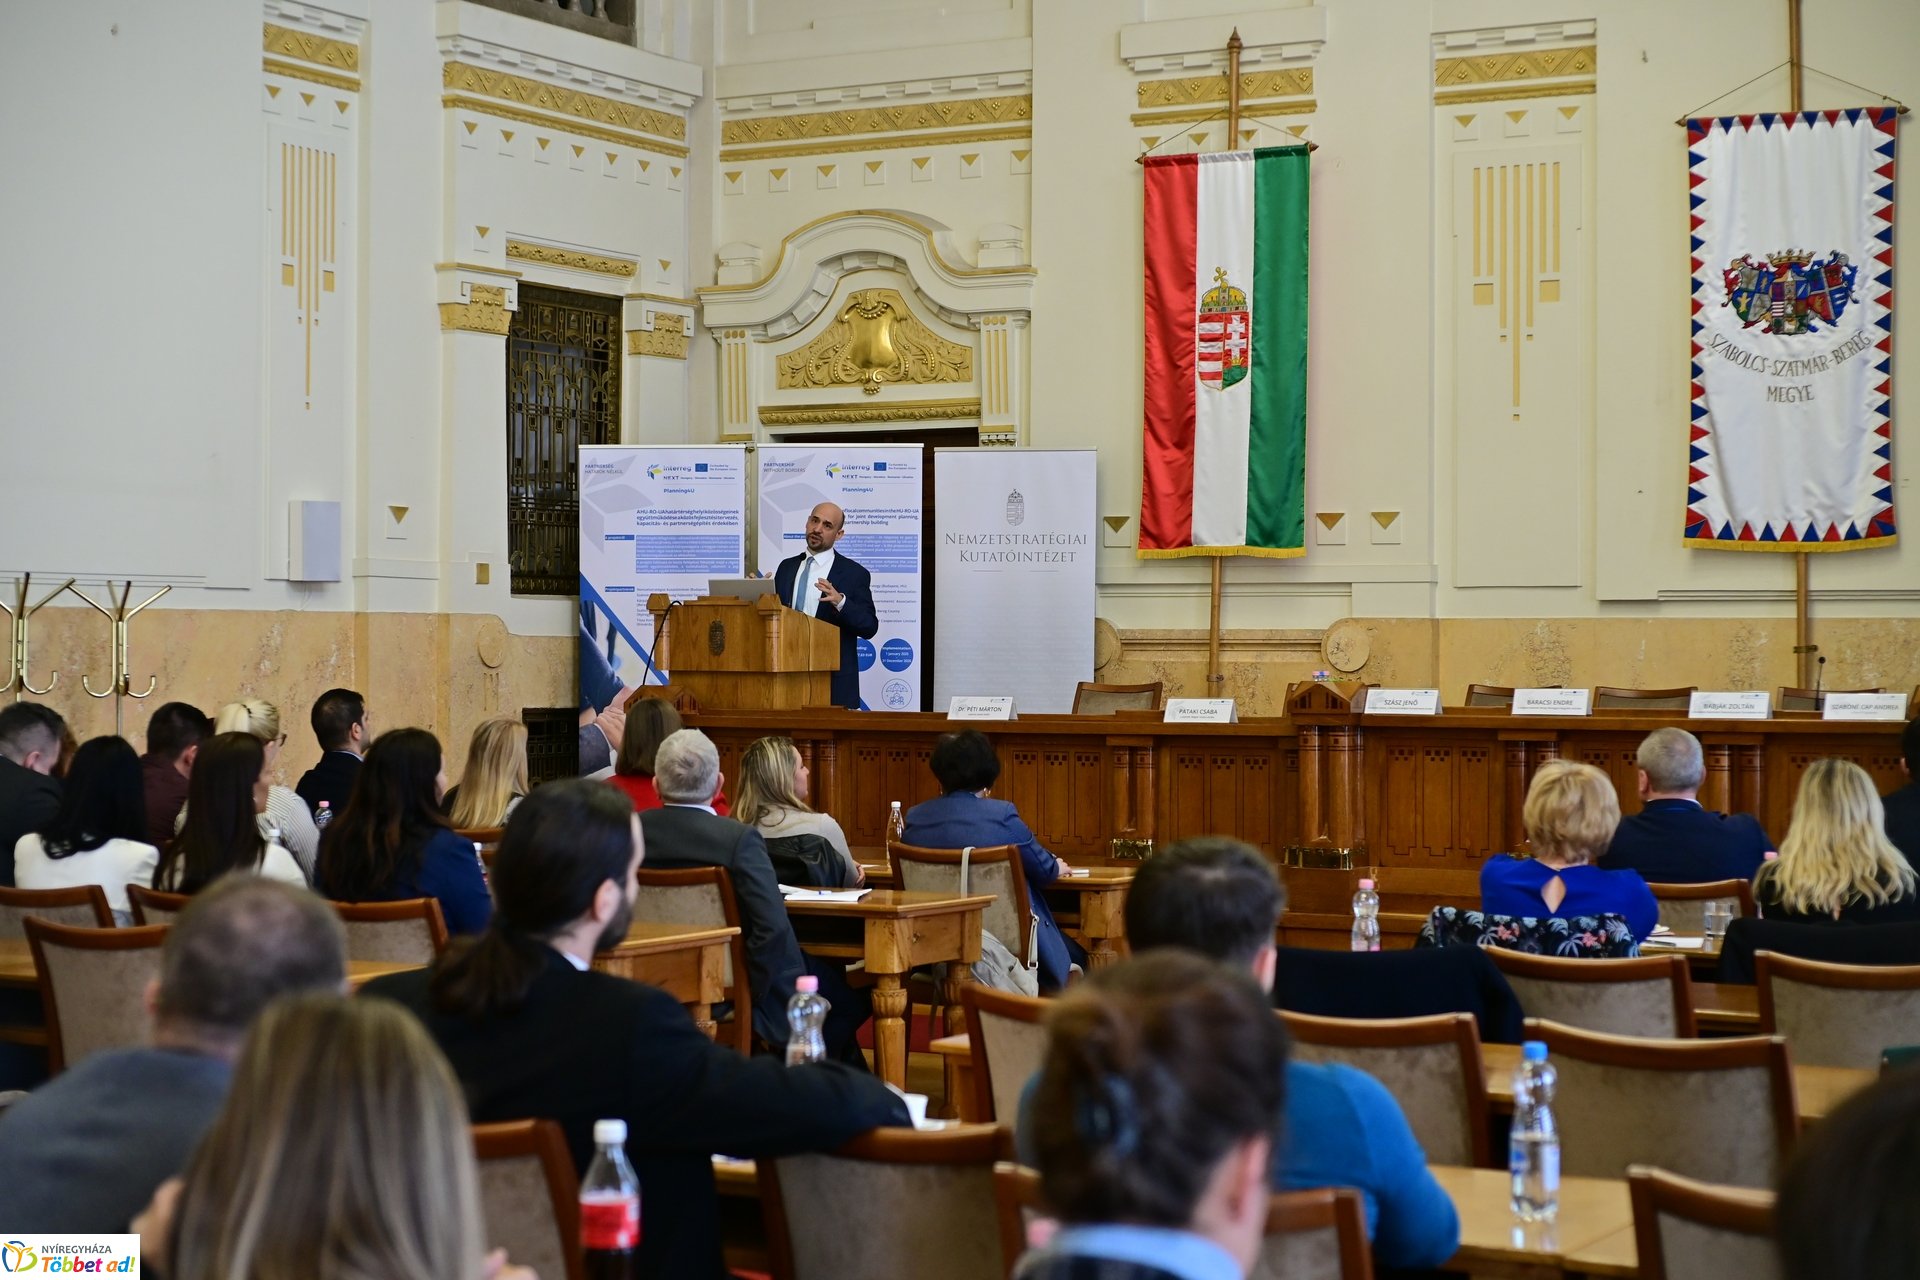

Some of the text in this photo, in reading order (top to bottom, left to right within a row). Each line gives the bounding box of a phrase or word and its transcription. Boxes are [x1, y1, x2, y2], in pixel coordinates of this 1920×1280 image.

[1766, 384, 1815, 403] MEGYE
[945, 532, 1087, 545] NEMZETSTRATÉGIAI
[960, 550, 1077, 562] KUTATÓINTÉZET
